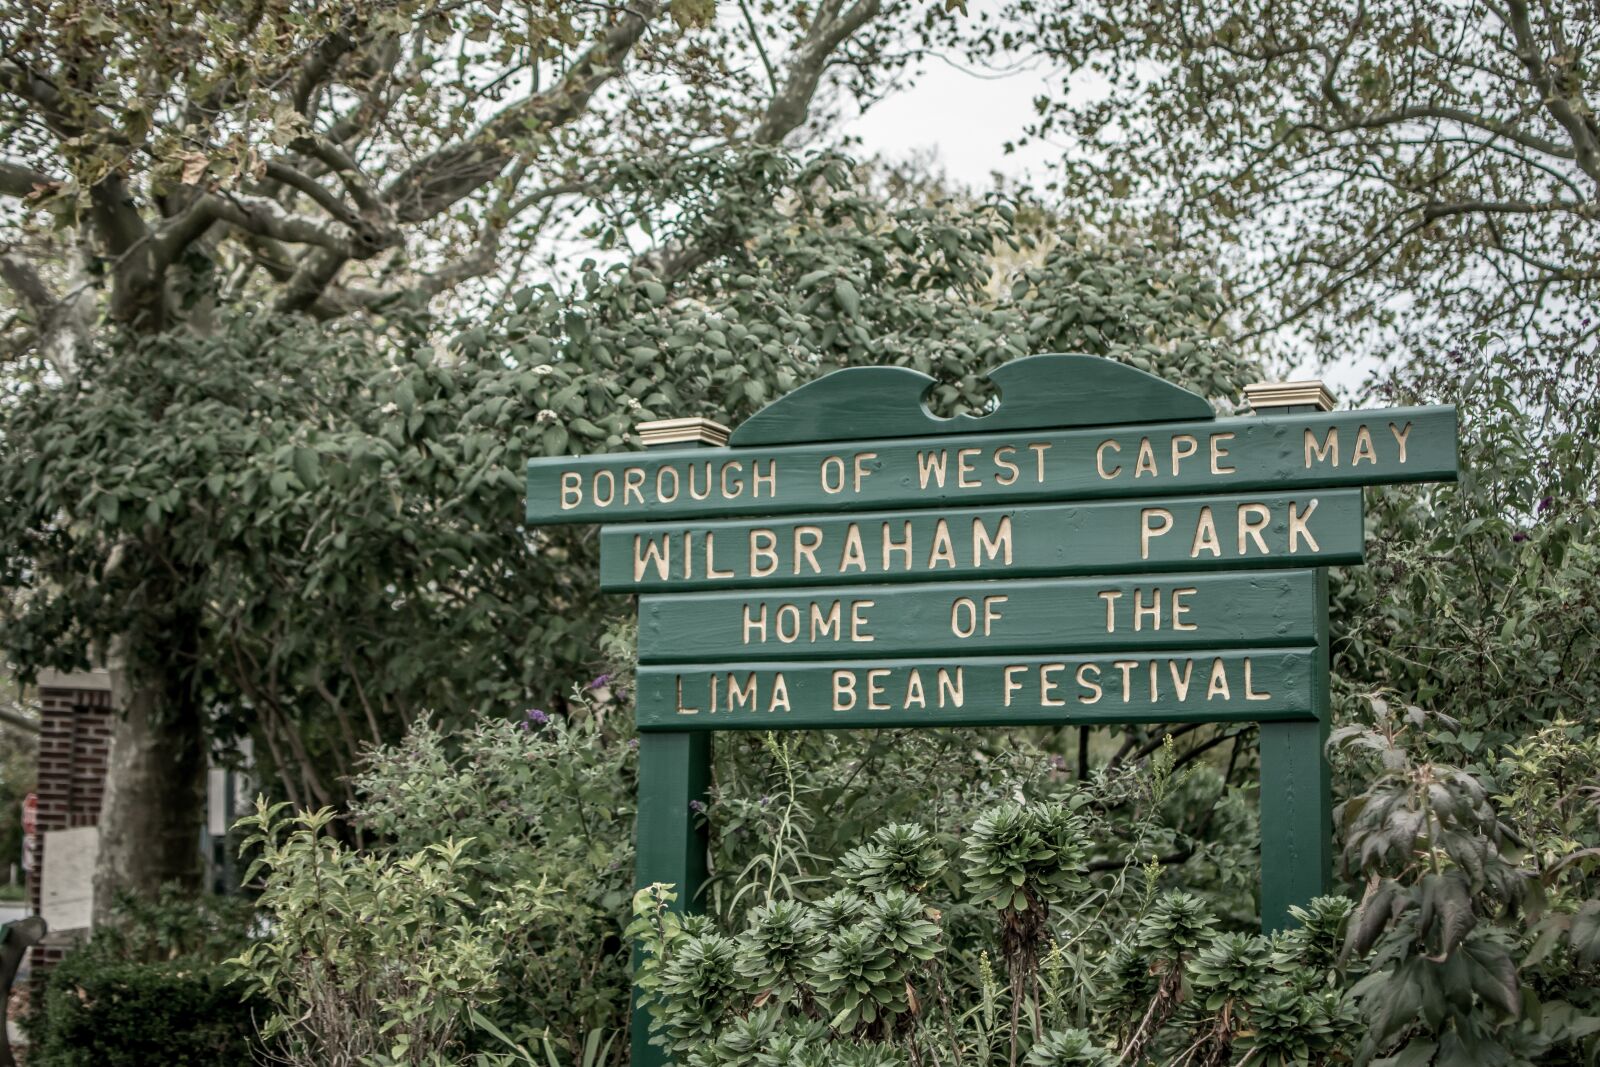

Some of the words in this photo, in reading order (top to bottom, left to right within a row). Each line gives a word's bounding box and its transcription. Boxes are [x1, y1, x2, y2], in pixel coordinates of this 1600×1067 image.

[561, 459, 777, 510] BOROUGH
[820, 452, 878, 494] OF
[917, 442, 1053, 490] WEST
[1096, 432, 1237, 480] CAPE
[1304, 421, 1413, 469] MAY
[633, 515, 1013, 583] WILBRAHAM
[1140, 499, 1320, 560] PARK
[743, 600, 875, 644] HOME
[951, 595, 1009, 639] OF
[1098, 588, 1198, 634] THE
[676, 671, 791, 715] LIMA
[832, 666, 965, 712] BEAN
[1004, 657, 1272, 707] FESTIVAL
